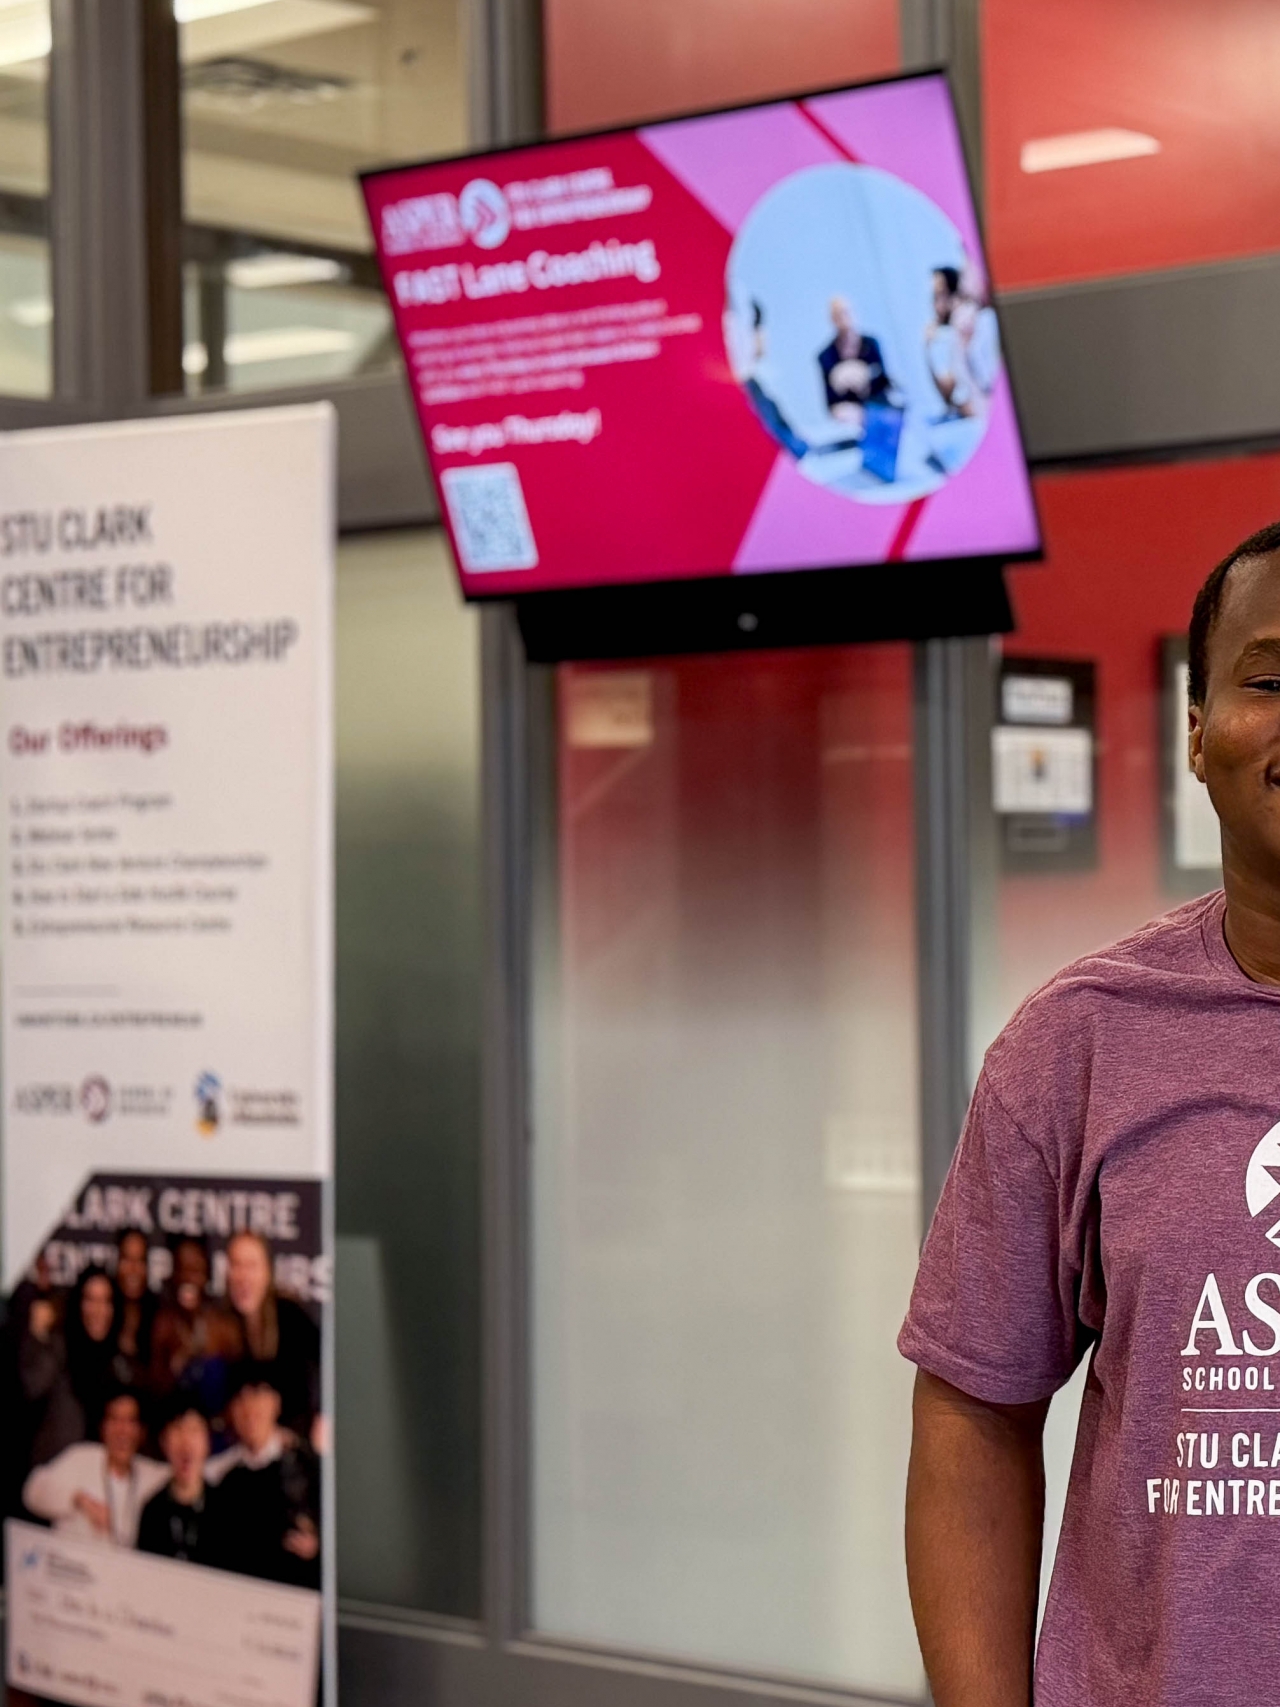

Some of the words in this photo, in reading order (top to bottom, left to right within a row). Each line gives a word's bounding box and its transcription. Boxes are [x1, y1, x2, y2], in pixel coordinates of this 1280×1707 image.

[463, 261, 528, 298] Lane
[529, 241, 659, 288] Coaching
[0, 510, 51, 555] STU
[58, 503, 152, 550] CLARK
[3, 569, 107, 614] CENTRE
[115, 562, 173, 606] FOR
[3, 617, 297, 678] ENTREPRENEURSHIP
[8, 726, 49, 756] Our
[58, 720, 168, 757] Offerings
[158, 1187, 299, 1241] CENTRE
[1182, 1365, 1275, 1391] SCHOOL
[1176, 1432, 1219, 1469] STU
